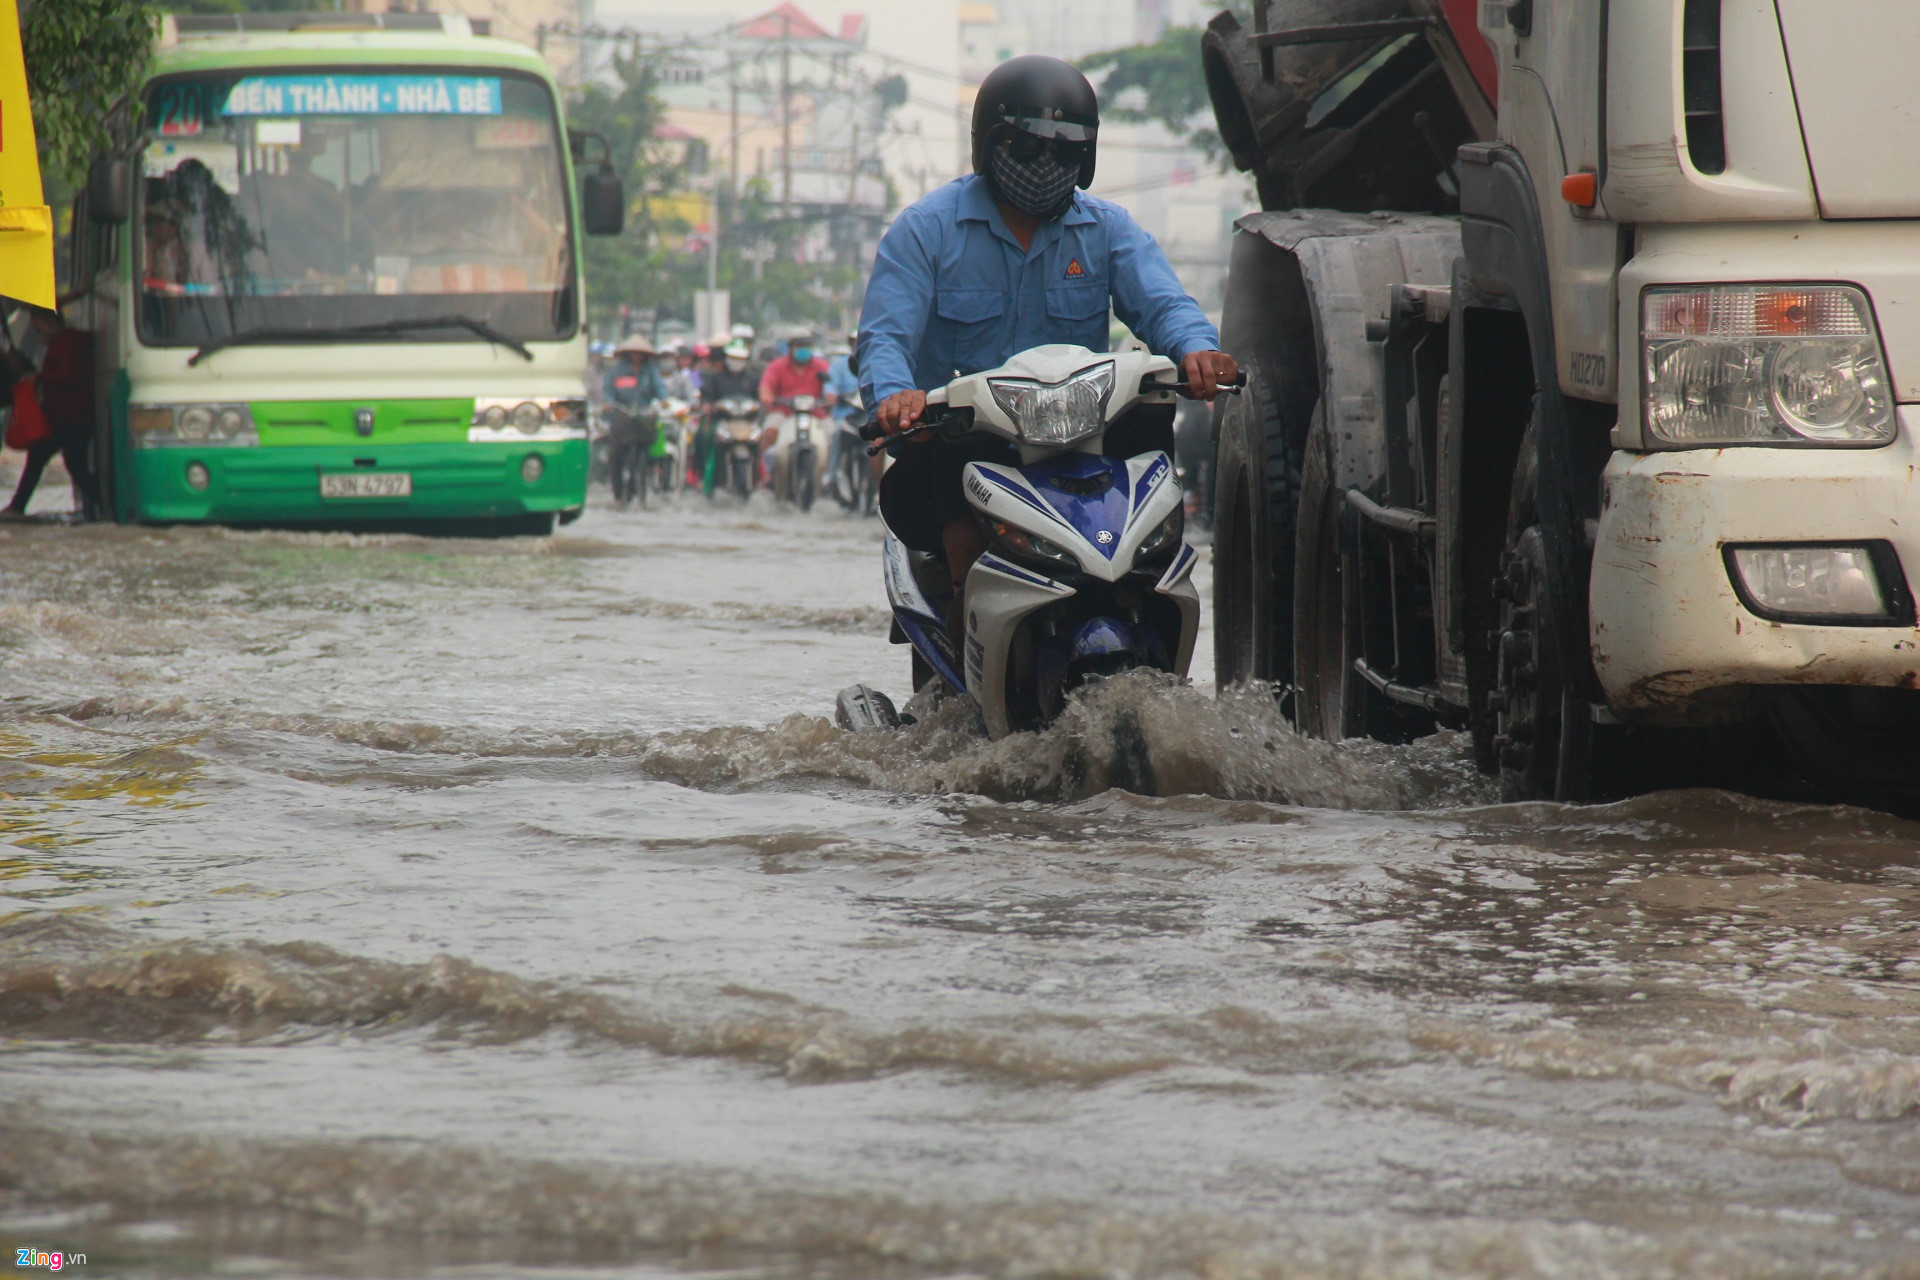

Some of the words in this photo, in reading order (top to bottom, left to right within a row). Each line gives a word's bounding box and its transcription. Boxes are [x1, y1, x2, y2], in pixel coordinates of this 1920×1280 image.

[162, 87, 201, 135] 20
[290, 78, 378, 113] THÀNH
[397, 79, 452, 113] NHÀ
[1570, 351, 1606, 387] HD270
[966, 473, 993, 506] YAMAHA
